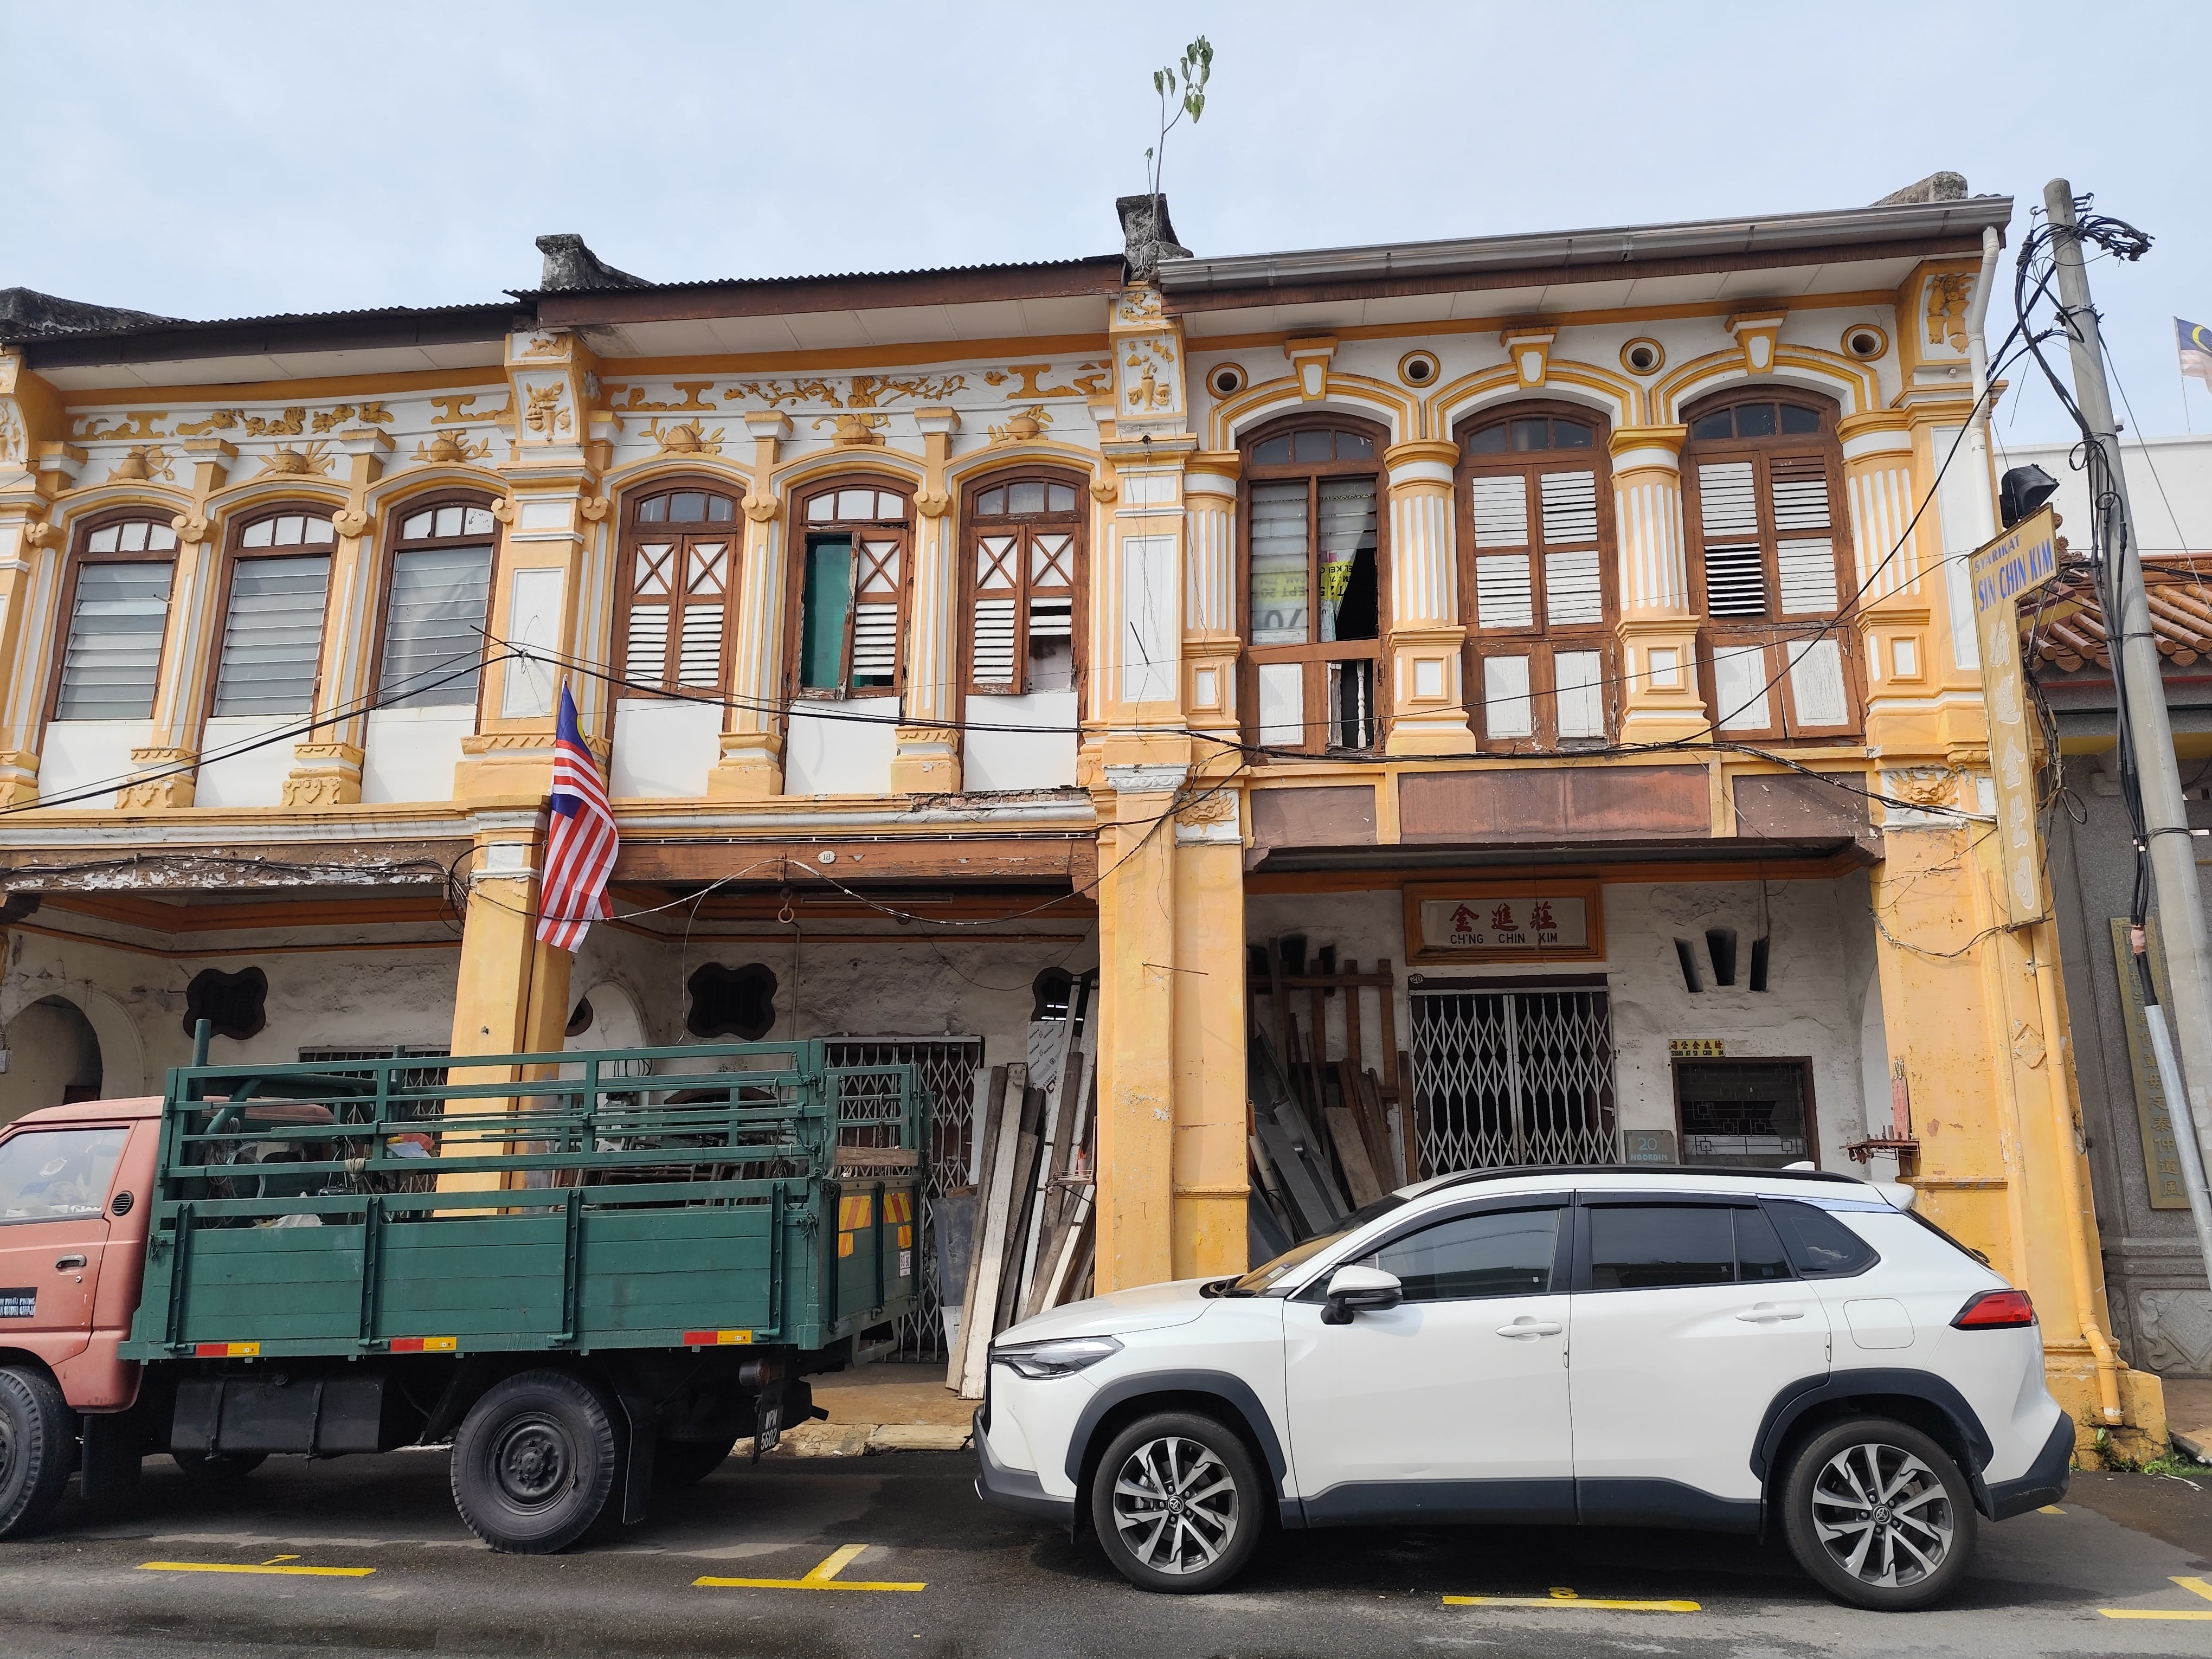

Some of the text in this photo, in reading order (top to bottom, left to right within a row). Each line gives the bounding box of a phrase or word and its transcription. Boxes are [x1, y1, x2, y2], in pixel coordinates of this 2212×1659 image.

[1975, 534, 2020, 573] SYARIKAT
[1978, 537, 2053, 612] SIN CHIN KIM
[1450, 932, 1558, 944] CH'NG CHIN KIM
[1638, 1137, 1657, 1151] 20
[761, 1427, 777, 1451] 5602
